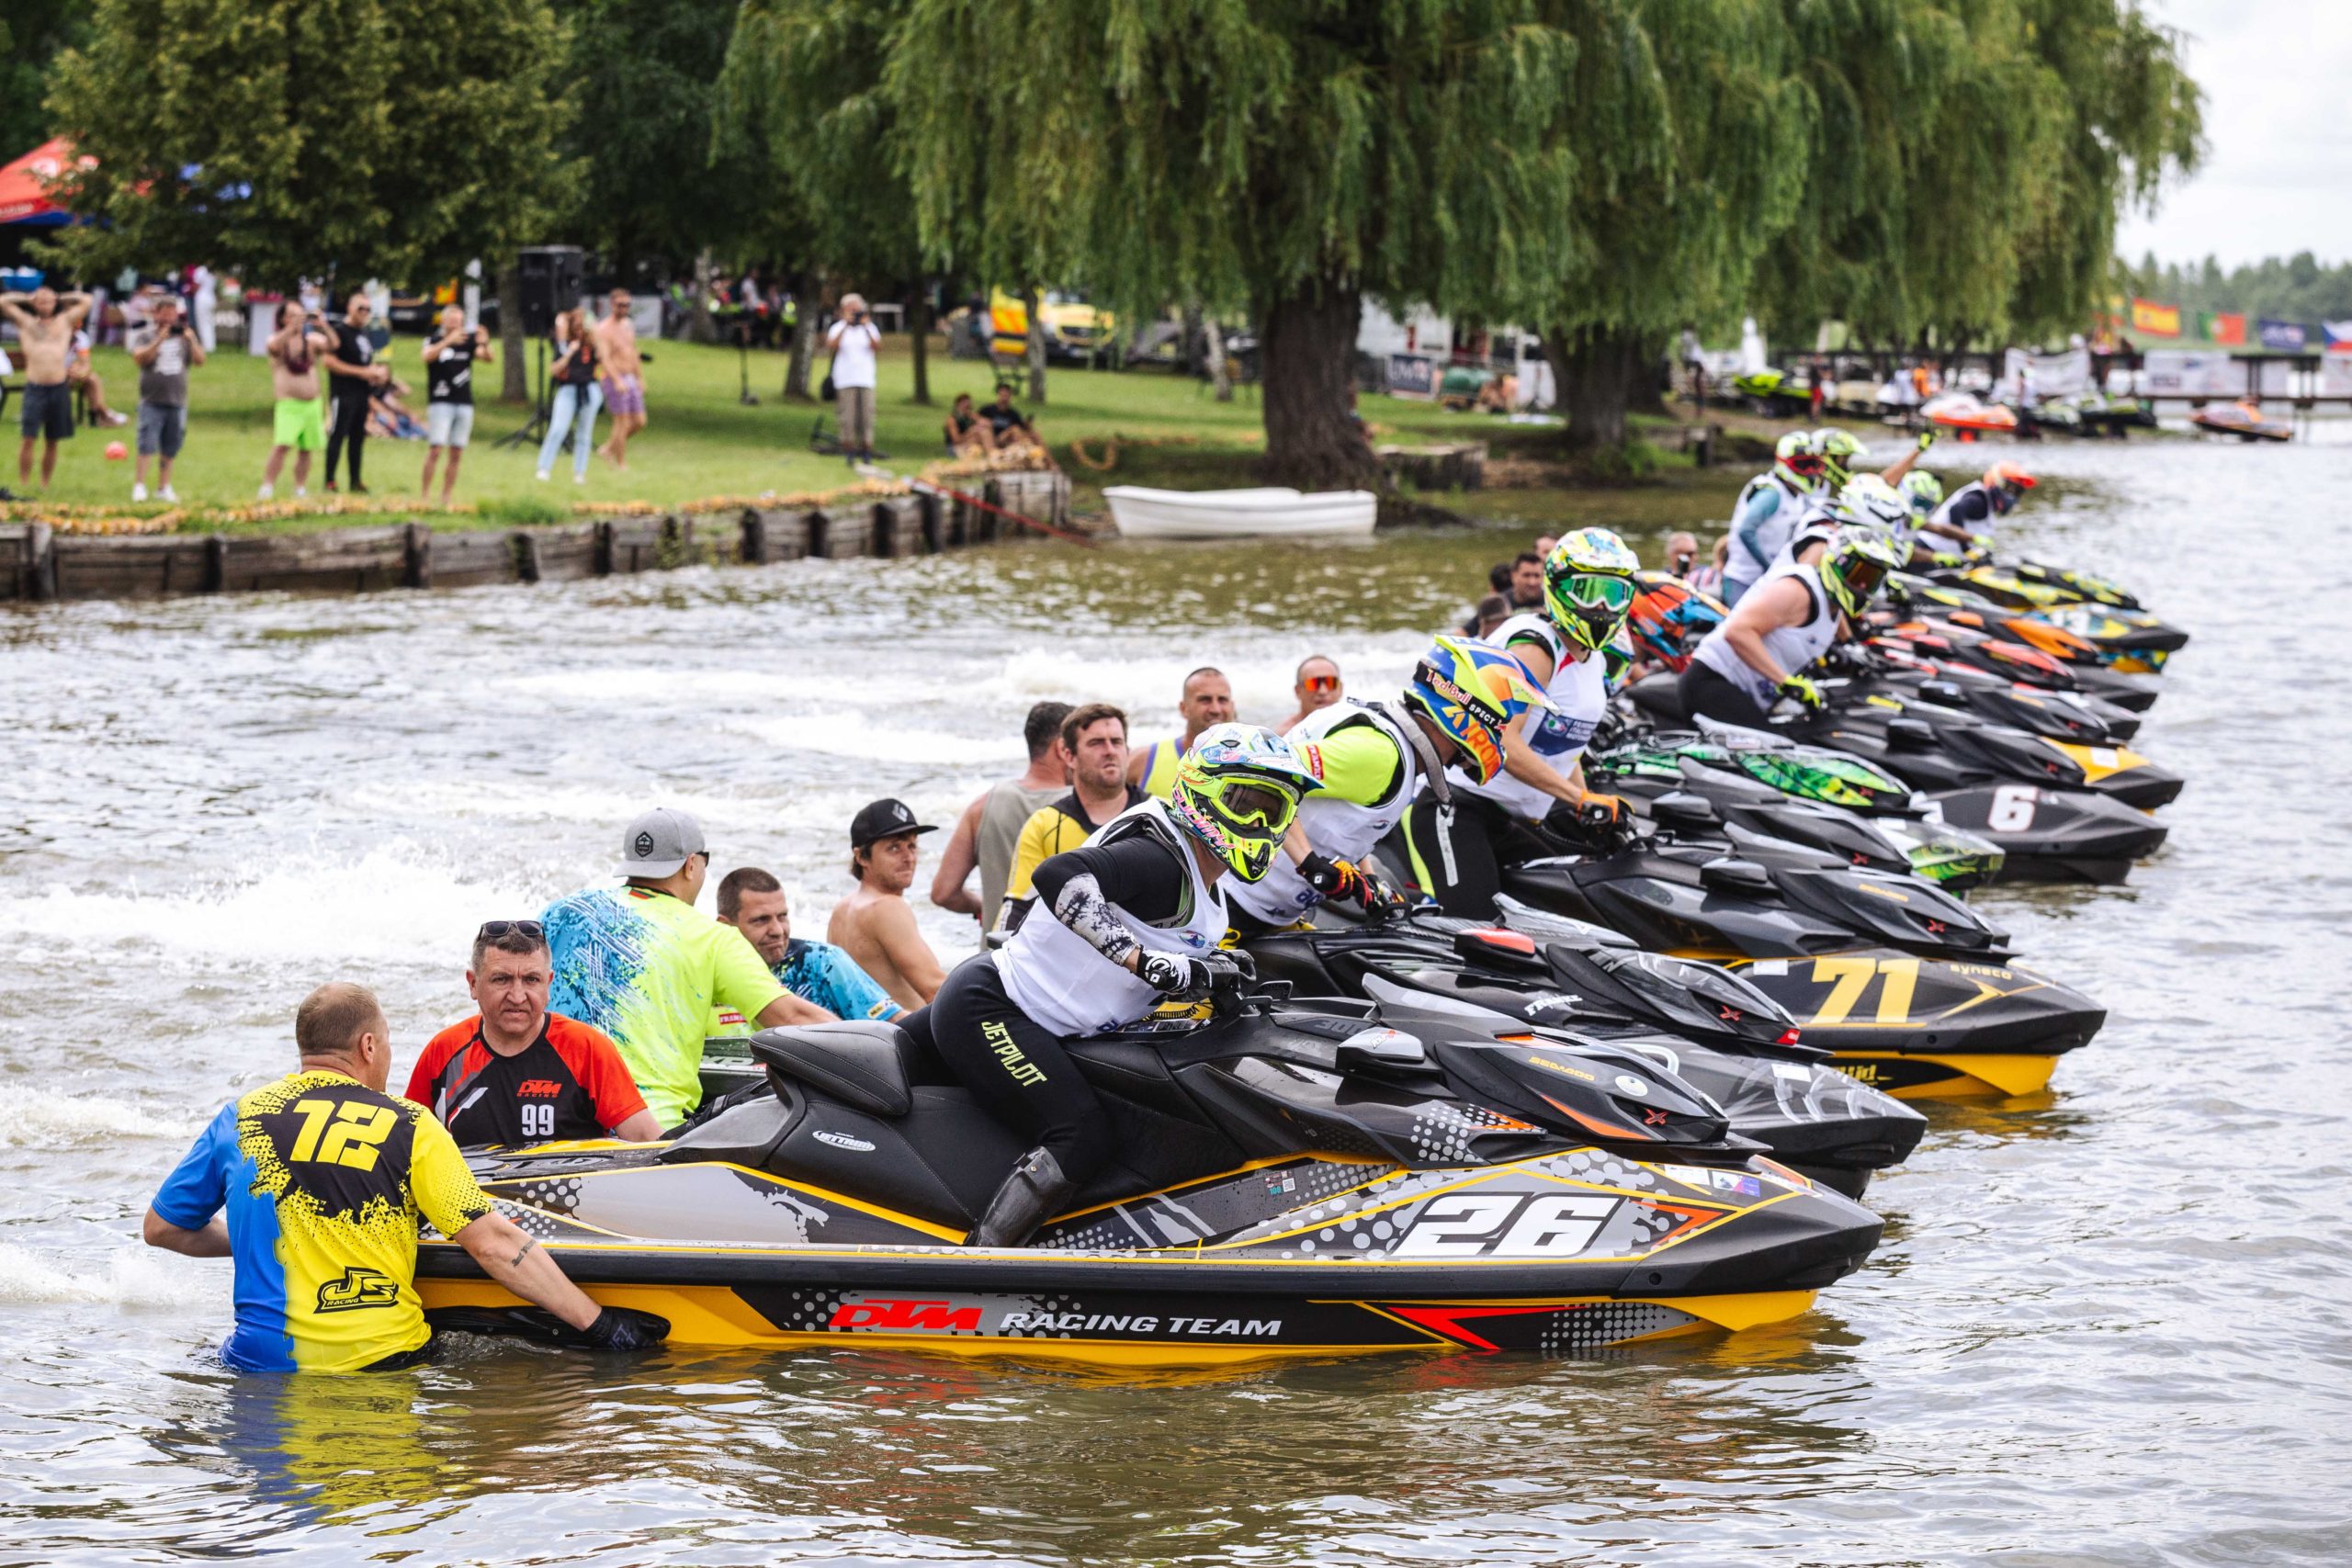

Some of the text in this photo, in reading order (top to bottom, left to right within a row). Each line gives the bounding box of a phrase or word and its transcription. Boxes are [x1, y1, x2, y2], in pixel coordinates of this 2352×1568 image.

[1426, 668, 1496, 725] Red Bull SPECT
[1172, 784, 1236, 851] SUOMY
[1988, 785, 2038, 831] 6
[1809, 957, 1920, 1023] 71
[981, 1021, 1047, 1087] JETPILOT
[521, 1104, 555, 1136] 99
[1390, 1195, 1620, 1257] 26
[327, 1297, 360, 1306] RACING
[828, 1298, 1283, 1337] DTM RACING TEAM
